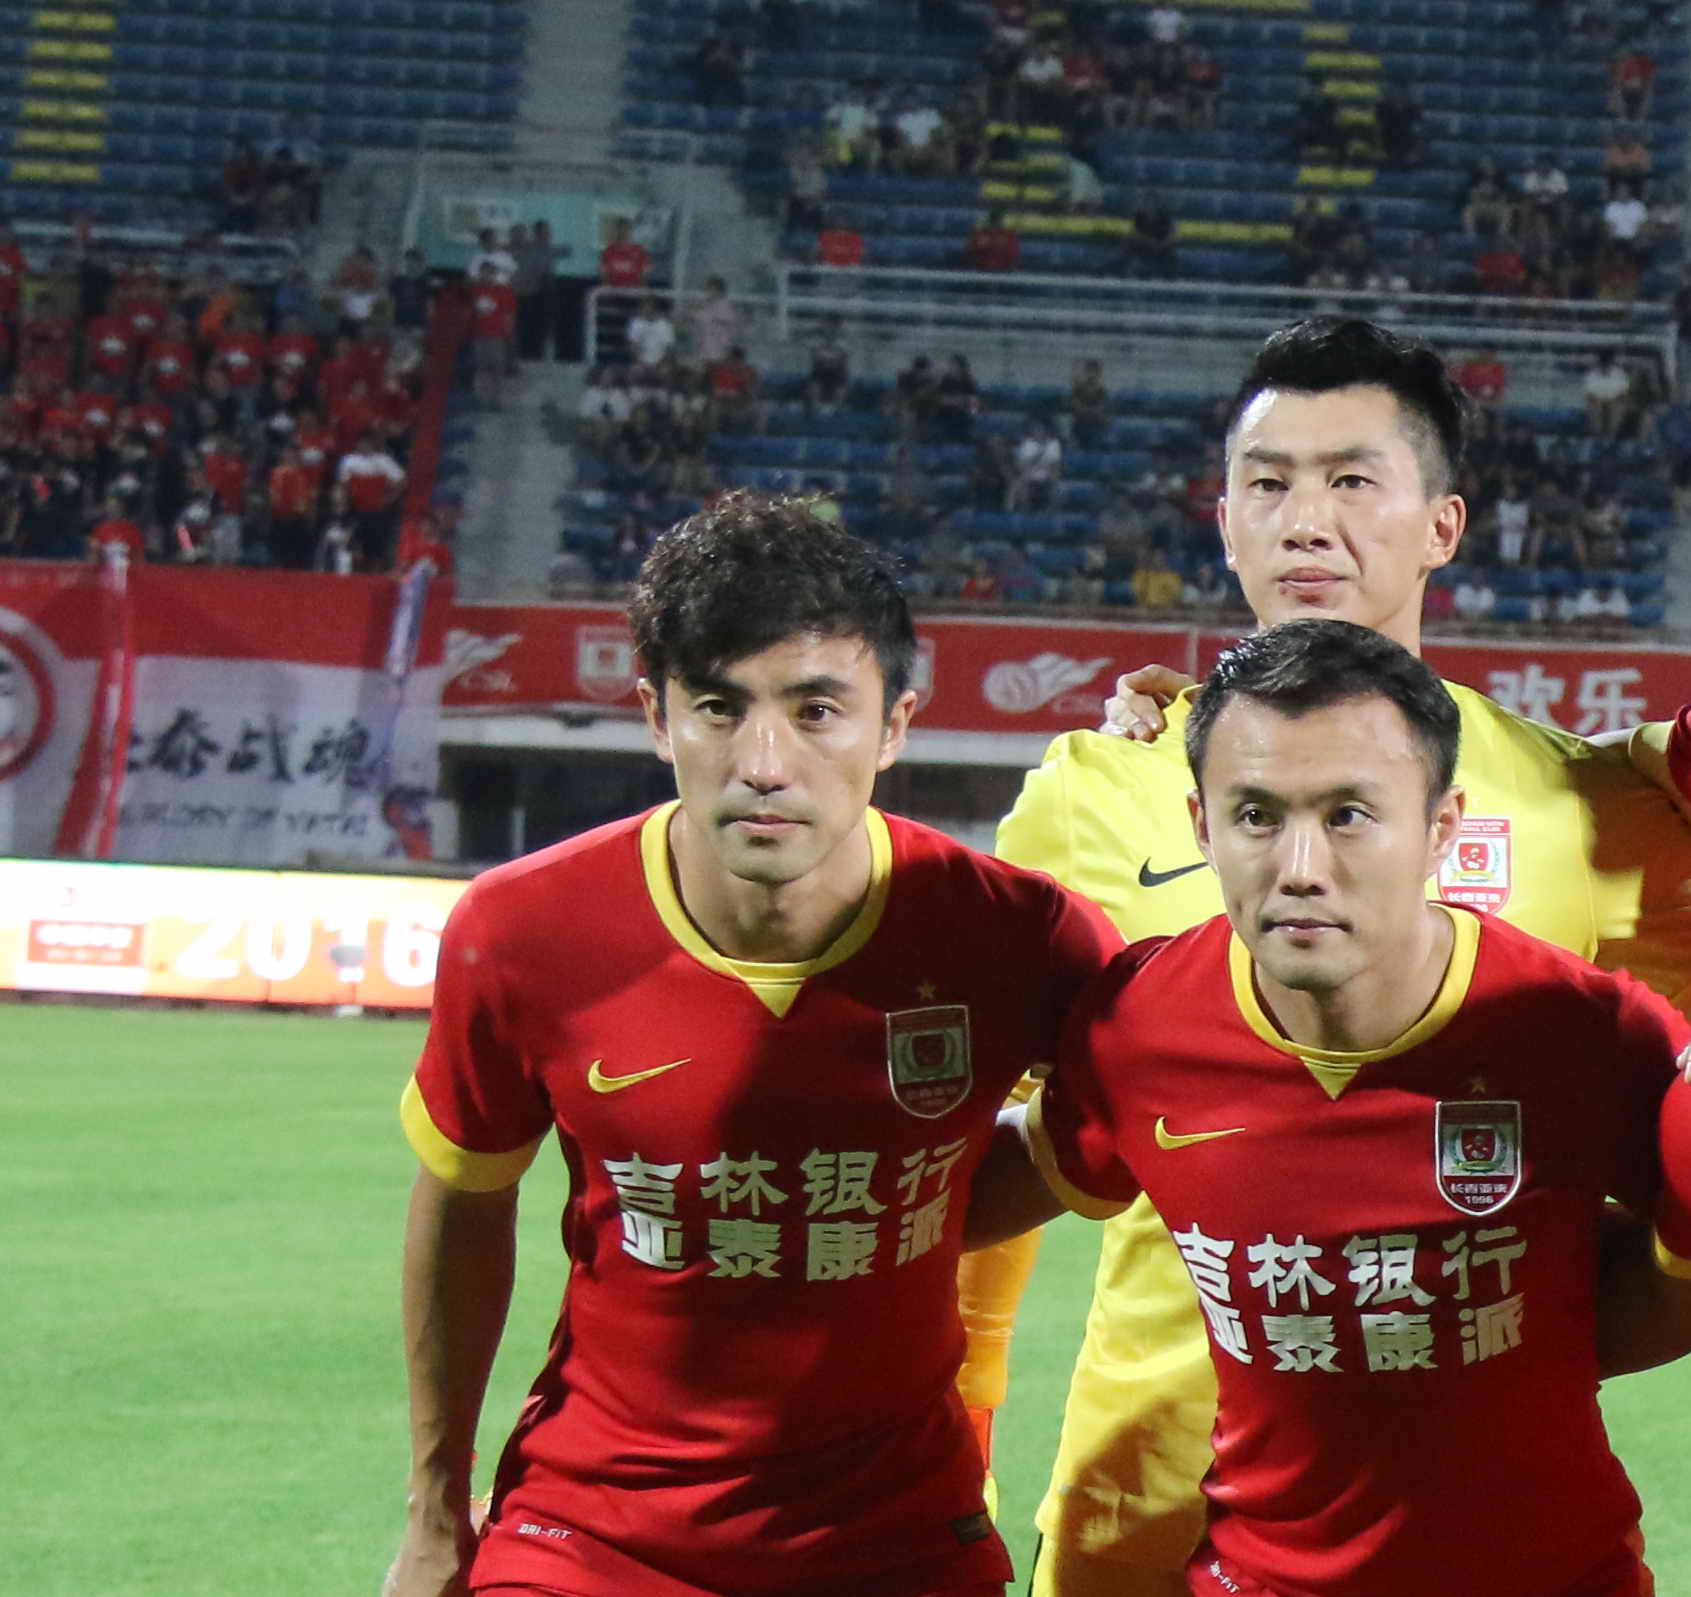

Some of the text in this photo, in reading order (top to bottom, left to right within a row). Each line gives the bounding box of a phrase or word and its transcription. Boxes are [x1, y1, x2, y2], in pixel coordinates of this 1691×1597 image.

[1488, 662, 1648, 735] 欢乐
[174, 905, 443, 987] 2016
[603, 1137, 968, 1217] 吉林银行
[620, 1192, 948, 1282] 亚泰康派
[1172, 1221, 1528, 1311] 吉林银行
[1198, 1292, 1526, 1375] 亚泰康派
